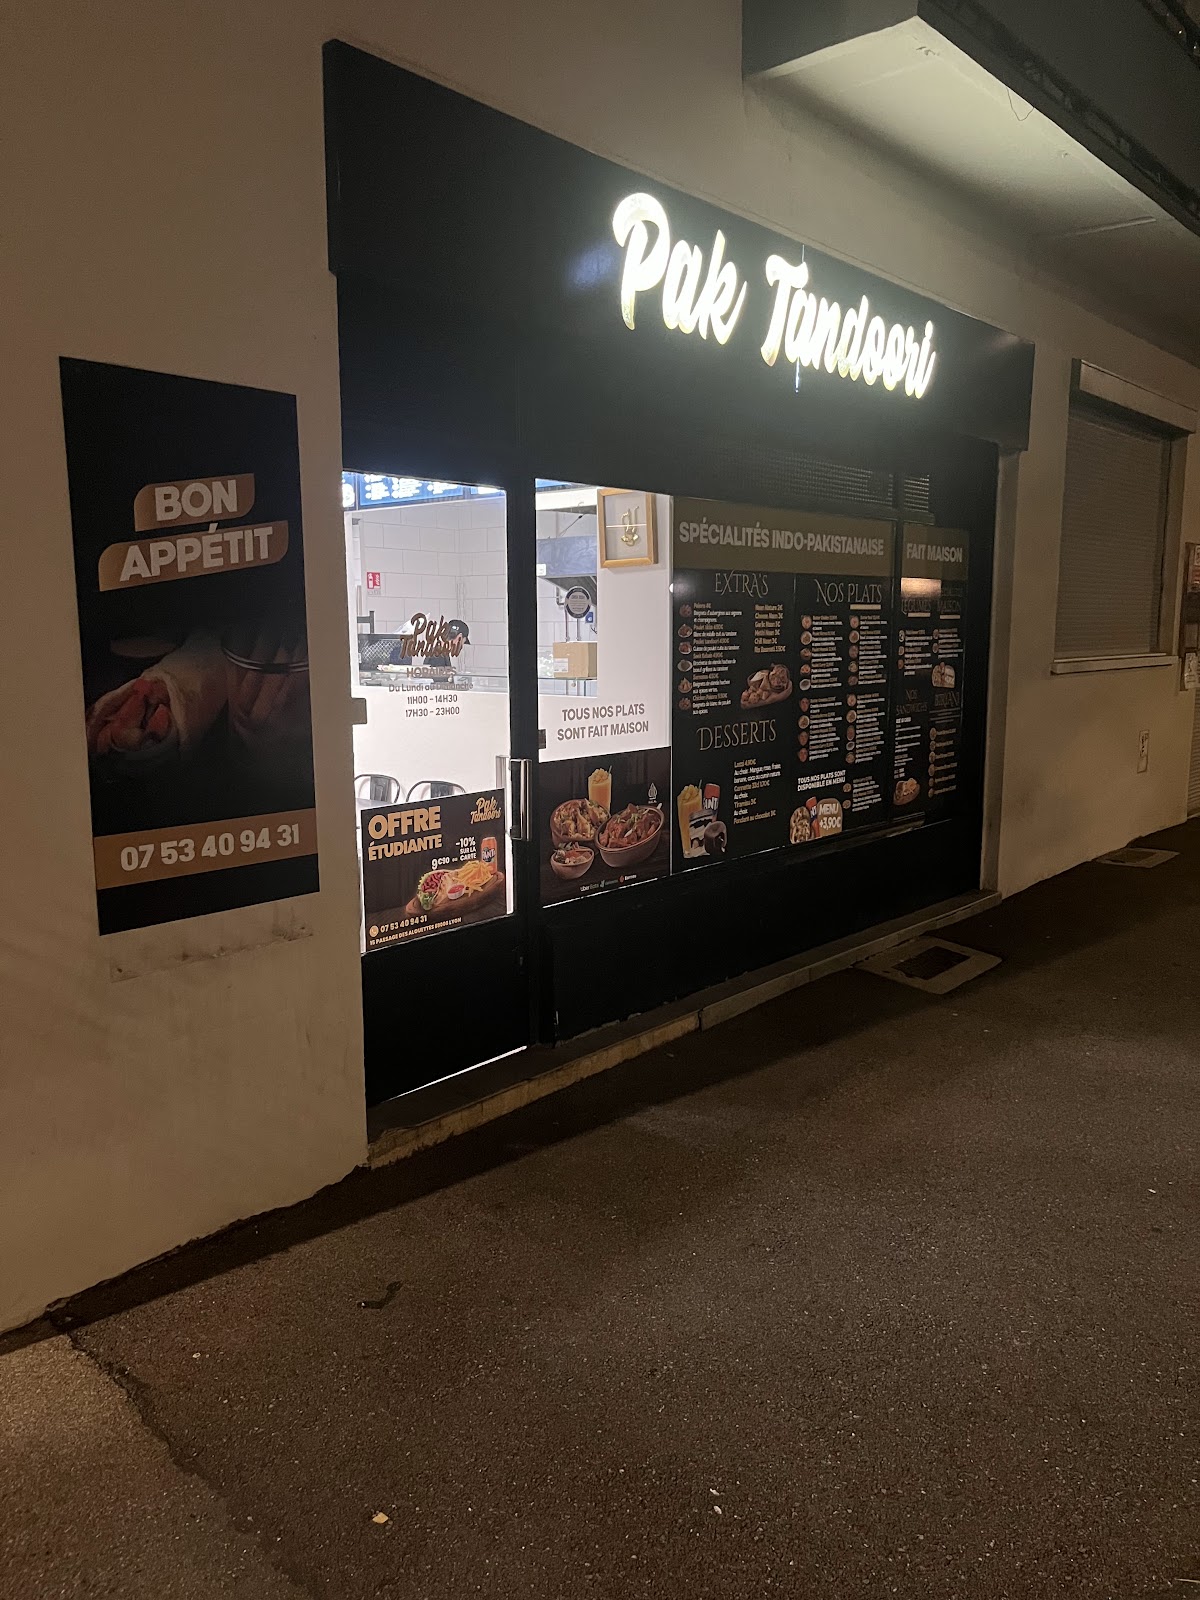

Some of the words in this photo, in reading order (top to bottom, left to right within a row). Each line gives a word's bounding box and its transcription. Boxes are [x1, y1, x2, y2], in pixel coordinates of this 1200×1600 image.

[613, 192, 747, 345] Pak
[761, 254, 936, 398] Tandoori
[155, 480, 237, 521] BON
[680, 517, 769, 548] SPÉCIALITÉS
[772, 530, 884, 555] INDO-PAKISTANAISE
[120, 523, 272, 582] APPÉTIT
[907, 543, 926, 560] FAIT
[927, 545, 962, 562] MAISON
[715, 570, 769, 599] EXTRA'S
[814, 578, 844, 606] NOS
[847, 584, 882, 604] PLATS
[411, 613, 449, 644] Pak
[400, 636, 462, 659] Tandoori
[406, 667, 456, 678] HORAIRES
[389, 684, 400, 692] Du
[402, 683, 424, 691] Lundi
[407, 696, 428, 704] 11H00
[435, 694, 458, 703] 14H30
[405, 709, 428, 717] 17H30
[435, 707, 460, 716] 23H00
[562, 707, 590, 721] TOUS
[592, 705, 613, 719] NOS
[615, 703, 645, 717] PLATS
[557, 727, 586, 740] SONT
[588, 725, 608, 738] FAIT
[610, 721, 649, 736] MAISON
[696, 719, 777, 751] DESSERTS
[798, 776, 810, 784] TOUS
[811, 774, 820, 782] NOS
[820, 772, 833, 780] PLATS
[798, 780, 825, 791] DISPONIBLE
[826, 778, 832, 786] EN
[833, 776, 845, 784] MENU
[476, 796, 498, 812] Pak
[819, 802, 839, 815] MENU
[368, 806, 441, 840] OFFRE
[120, 843, 154, 872] 07
[161, 839, 196, 864] 53
[201, 833, 235, 857] 40
[240, 828, 271, 852] 94
[277, 823, 300, 846] 31
[368, 834, 442, 861] ÉTUDIANTE
[456, 837, 476, 847] -10%
[460, 853, 476, 861] CARTE
[376, 934, 398, 944] PASSAGE
[399, 931, 408, 939] DES
[449, 917, 462, 925] LYON
[380, 924, 389, 933] 07
[390, 922, 399, 930] 53
[400, 919, 409, 928] 40
[410, 917, 419, 925] 94
[420, 915, 428, 923] 31
